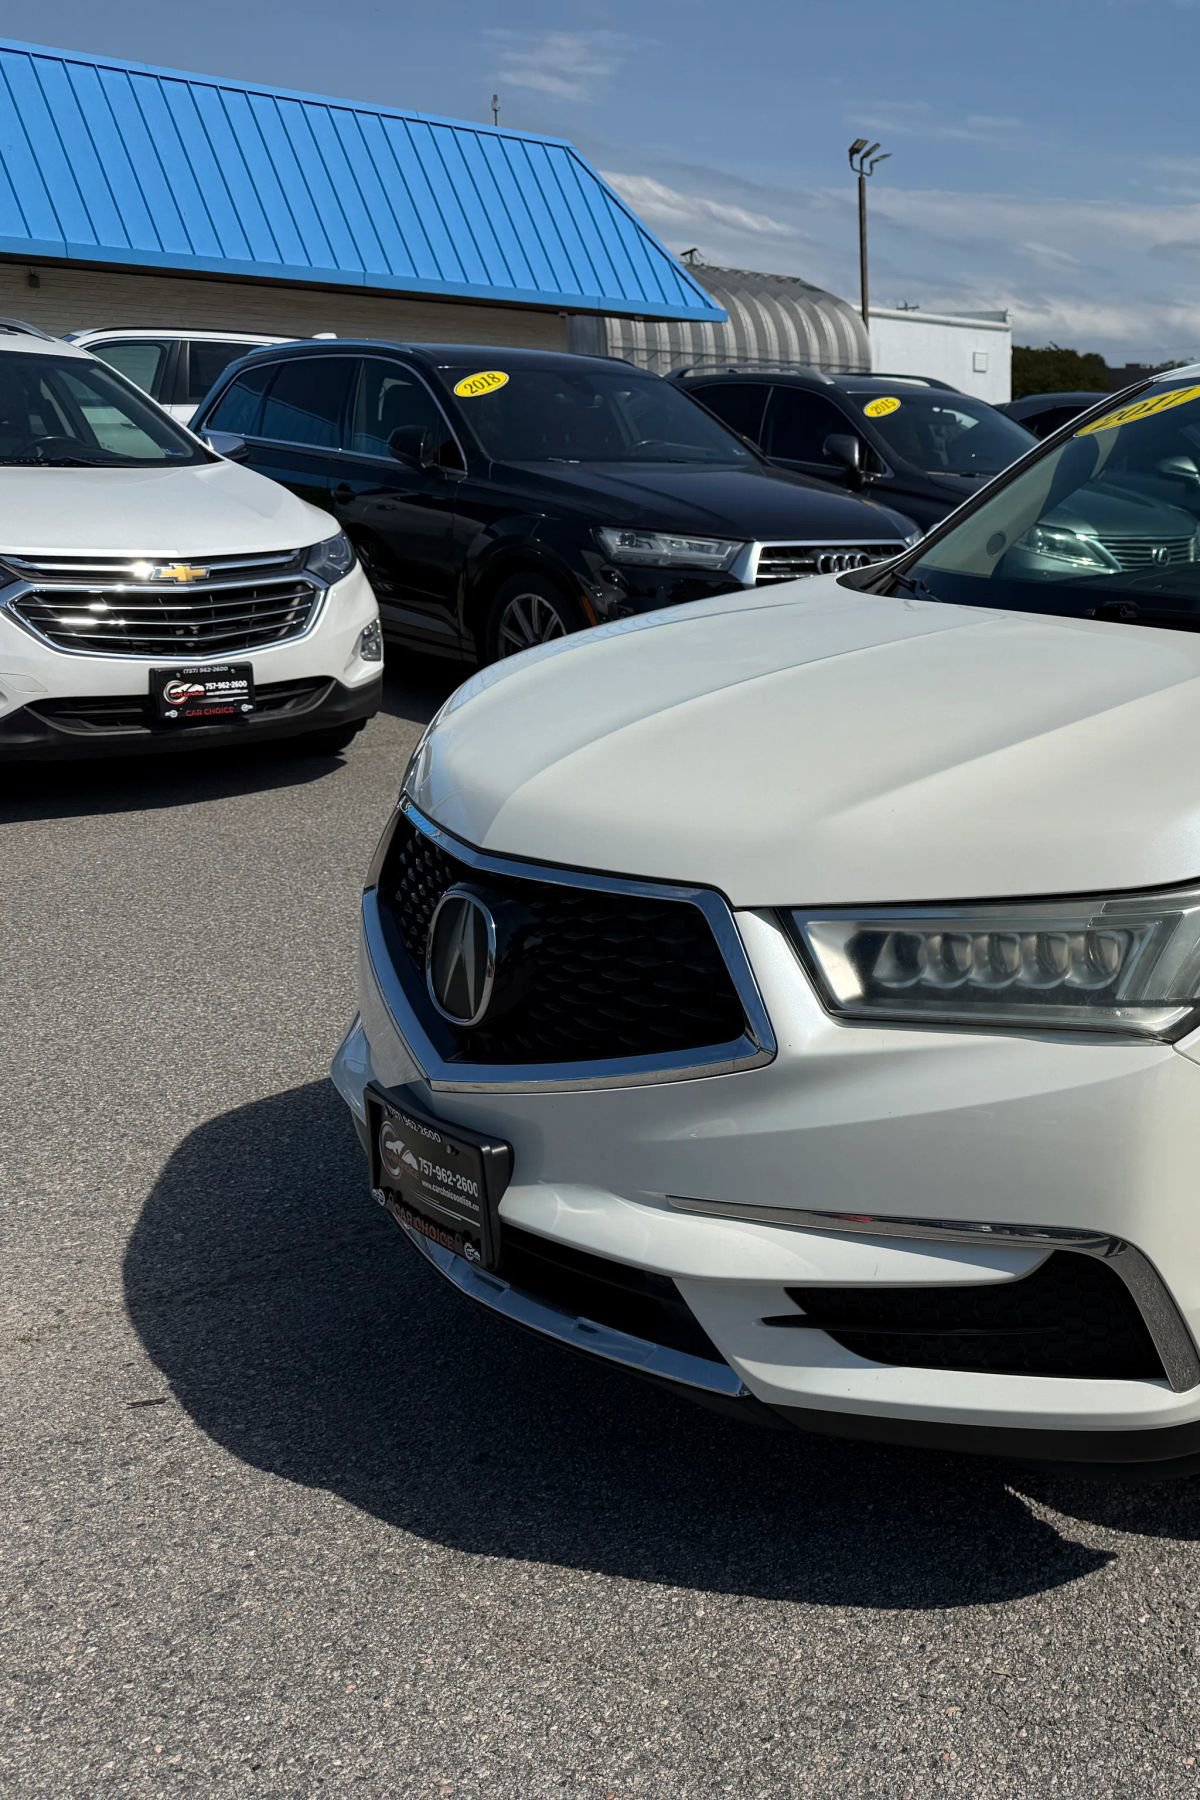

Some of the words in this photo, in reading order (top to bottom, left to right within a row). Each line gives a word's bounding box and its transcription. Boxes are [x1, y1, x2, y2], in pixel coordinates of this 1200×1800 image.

[464, 373, 501, 394] 2018
[870, 399, 897, 415] 2015
[1091, 387, 1196, 432] 2017
[205, 680, 247, 690] 757-962-2600
[185, 708, 202, 717] CAR
[204, 706, 235, 715] CHOICE
[418, 1156, 479, 1198] 757-962-2600
[394, 1202, 413, 1229] CAR
[415, 1214, 456, 1252] CHOICE
